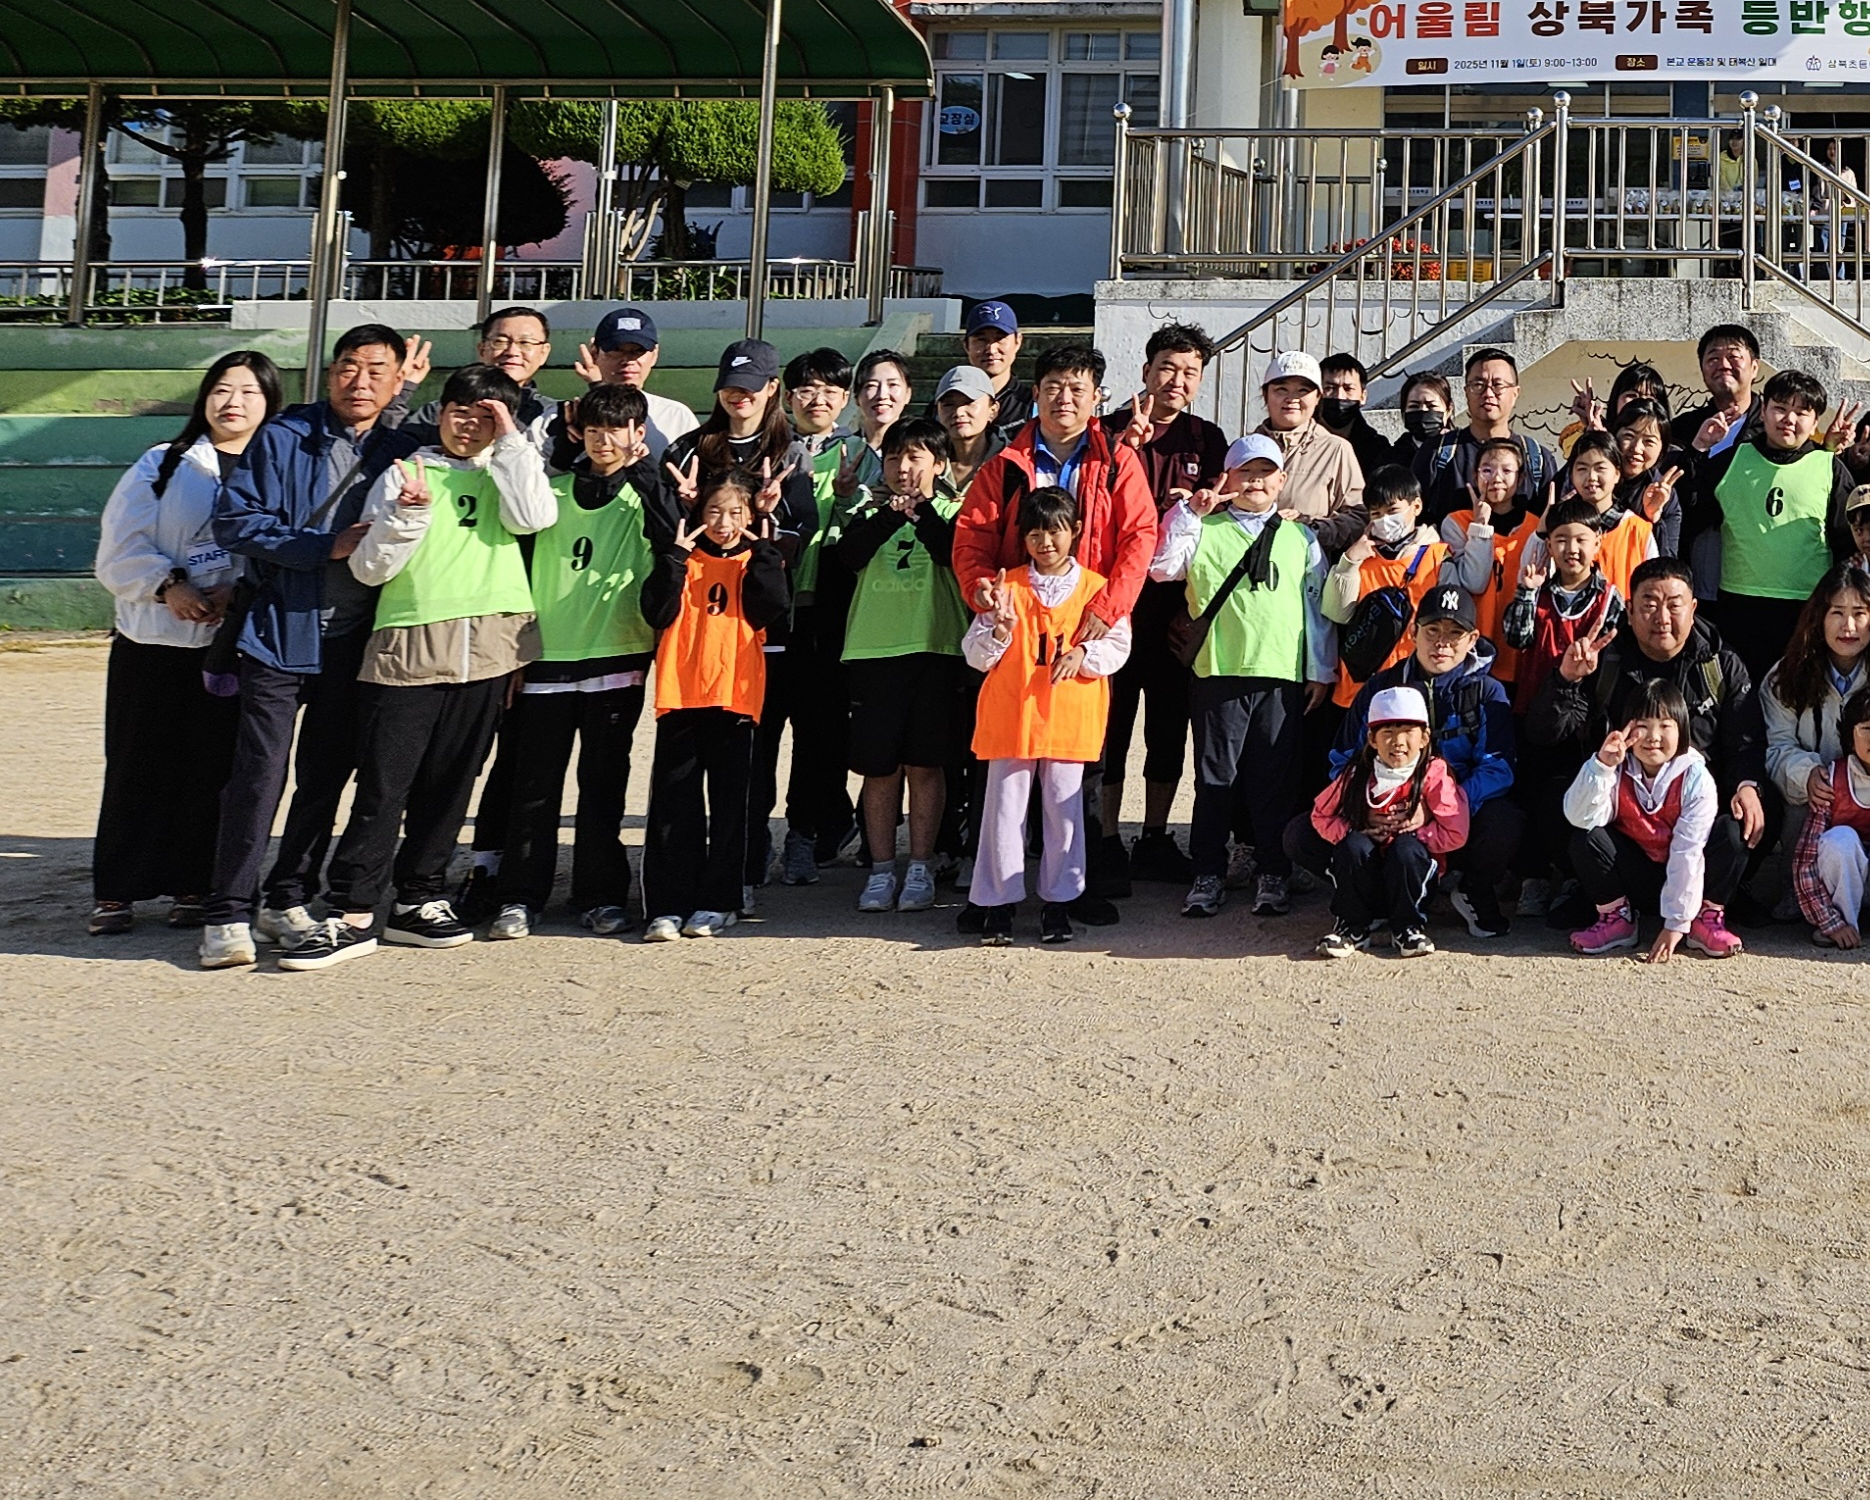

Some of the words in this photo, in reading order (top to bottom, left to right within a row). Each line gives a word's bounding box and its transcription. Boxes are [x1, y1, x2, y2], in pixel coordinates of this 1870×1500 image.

[1369, 0, 1501, 39] 어울림
[1527, 0, 1715, 37] 상북가족
[1417, 60, 1437, 71] 일시
[1454, 59, 1488, 70] 2025년
[1490, 59, 1509, 70] 11월
[1512, 58, 1542, 69] 1일(토)
[1626, 57, 1646, 68] 장소
[1666, 57, 1685, 68] 본교
[1687, 57, 1715, 68] 운동장
[1716, 57, 1726, 68] 및
[939, 112, 975, 127] 교장실
[457, 495, 479, 528] 2
[1765, 486, 1784, 518] 6
[188, 549, 230, 567] STAFF
[571, 536, 593, 571] 9
[896, 539, 916, 570] 7
[707, 582, 728, 616] 9
[1441, 590, 1460, 611] NY
[1034, 631, 1065, 667] 11
